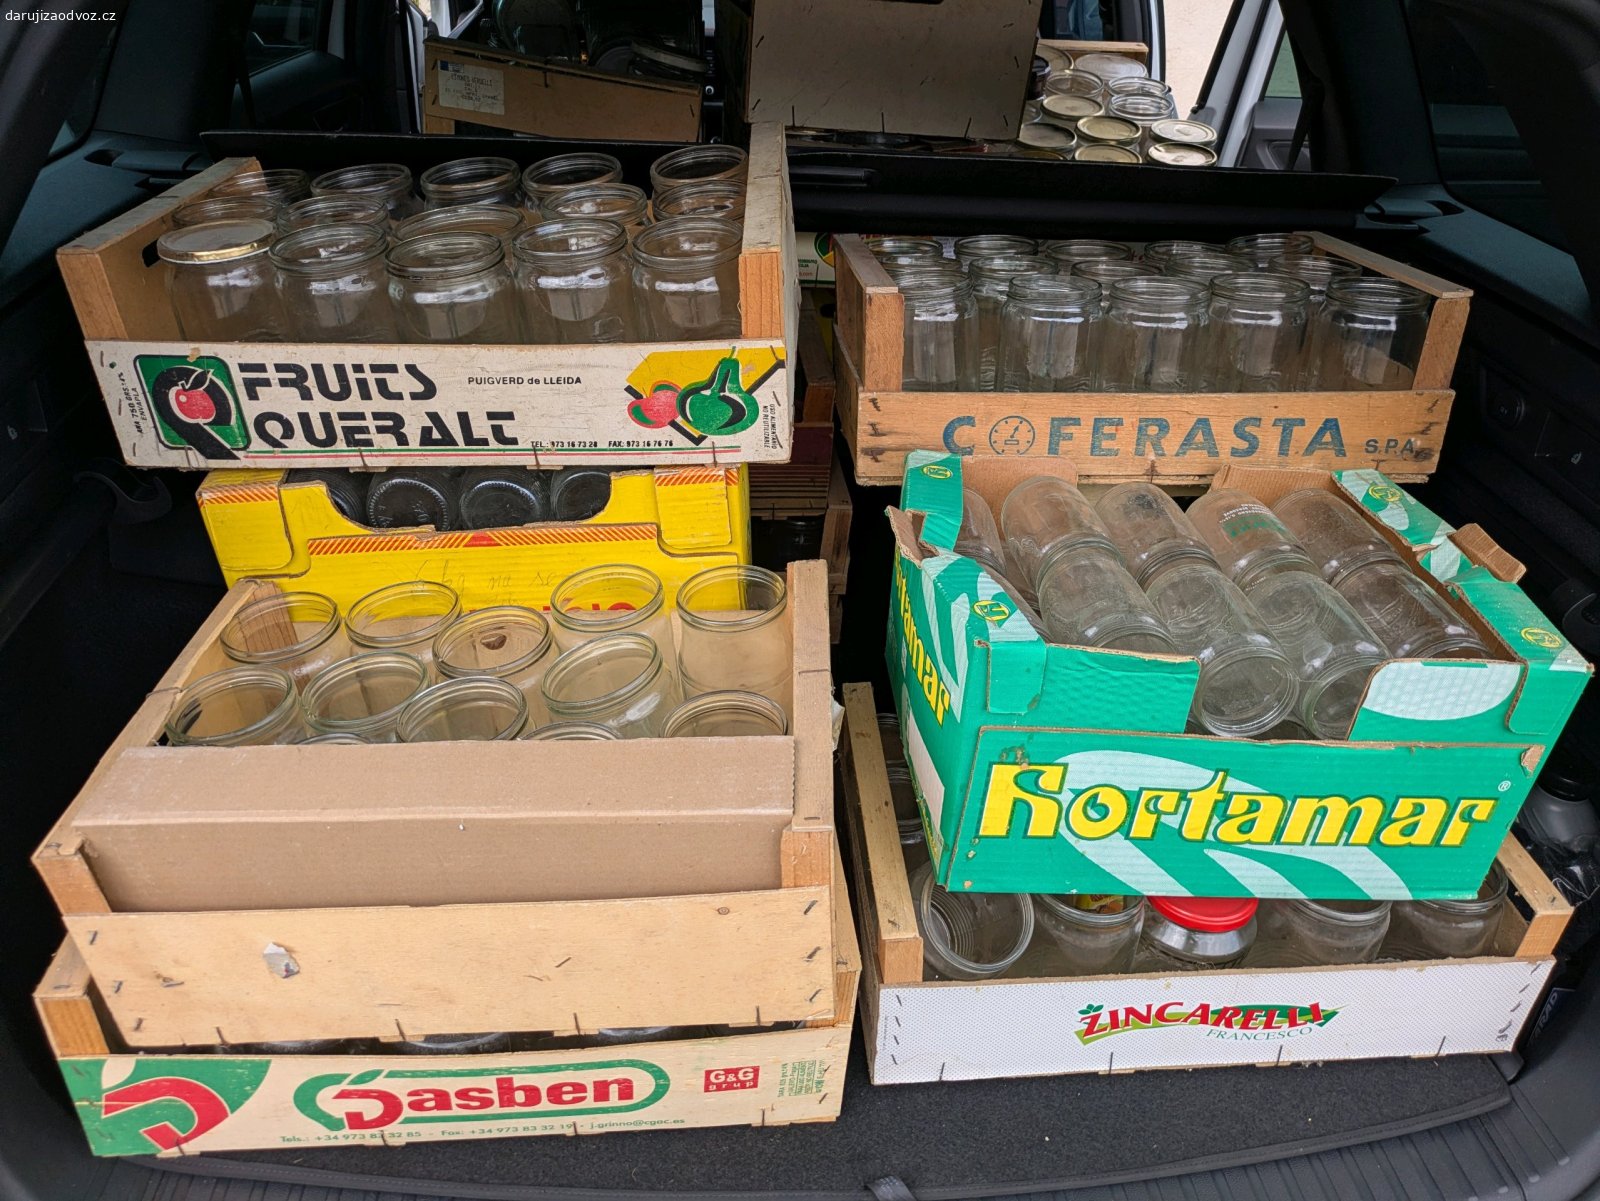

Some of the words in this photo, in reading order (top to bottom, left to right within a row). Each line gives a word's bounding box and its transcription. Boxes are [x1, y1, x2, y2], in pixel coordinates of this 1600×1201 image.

[467, 376, 525, 386] PUIGVERD
[527, 376, 541, 385] de
[543, 376, 583, 385] LLEIDA
[253, 411, 519, 449] QUERALT
[1079, 1001, 1325, 1038] ZINCARELLI
[1206, 1026, 1313, 1041] FRANCESCO
[709, 1067, 755, 1083] G&G
[708, 1081, 754, 1091] grup
